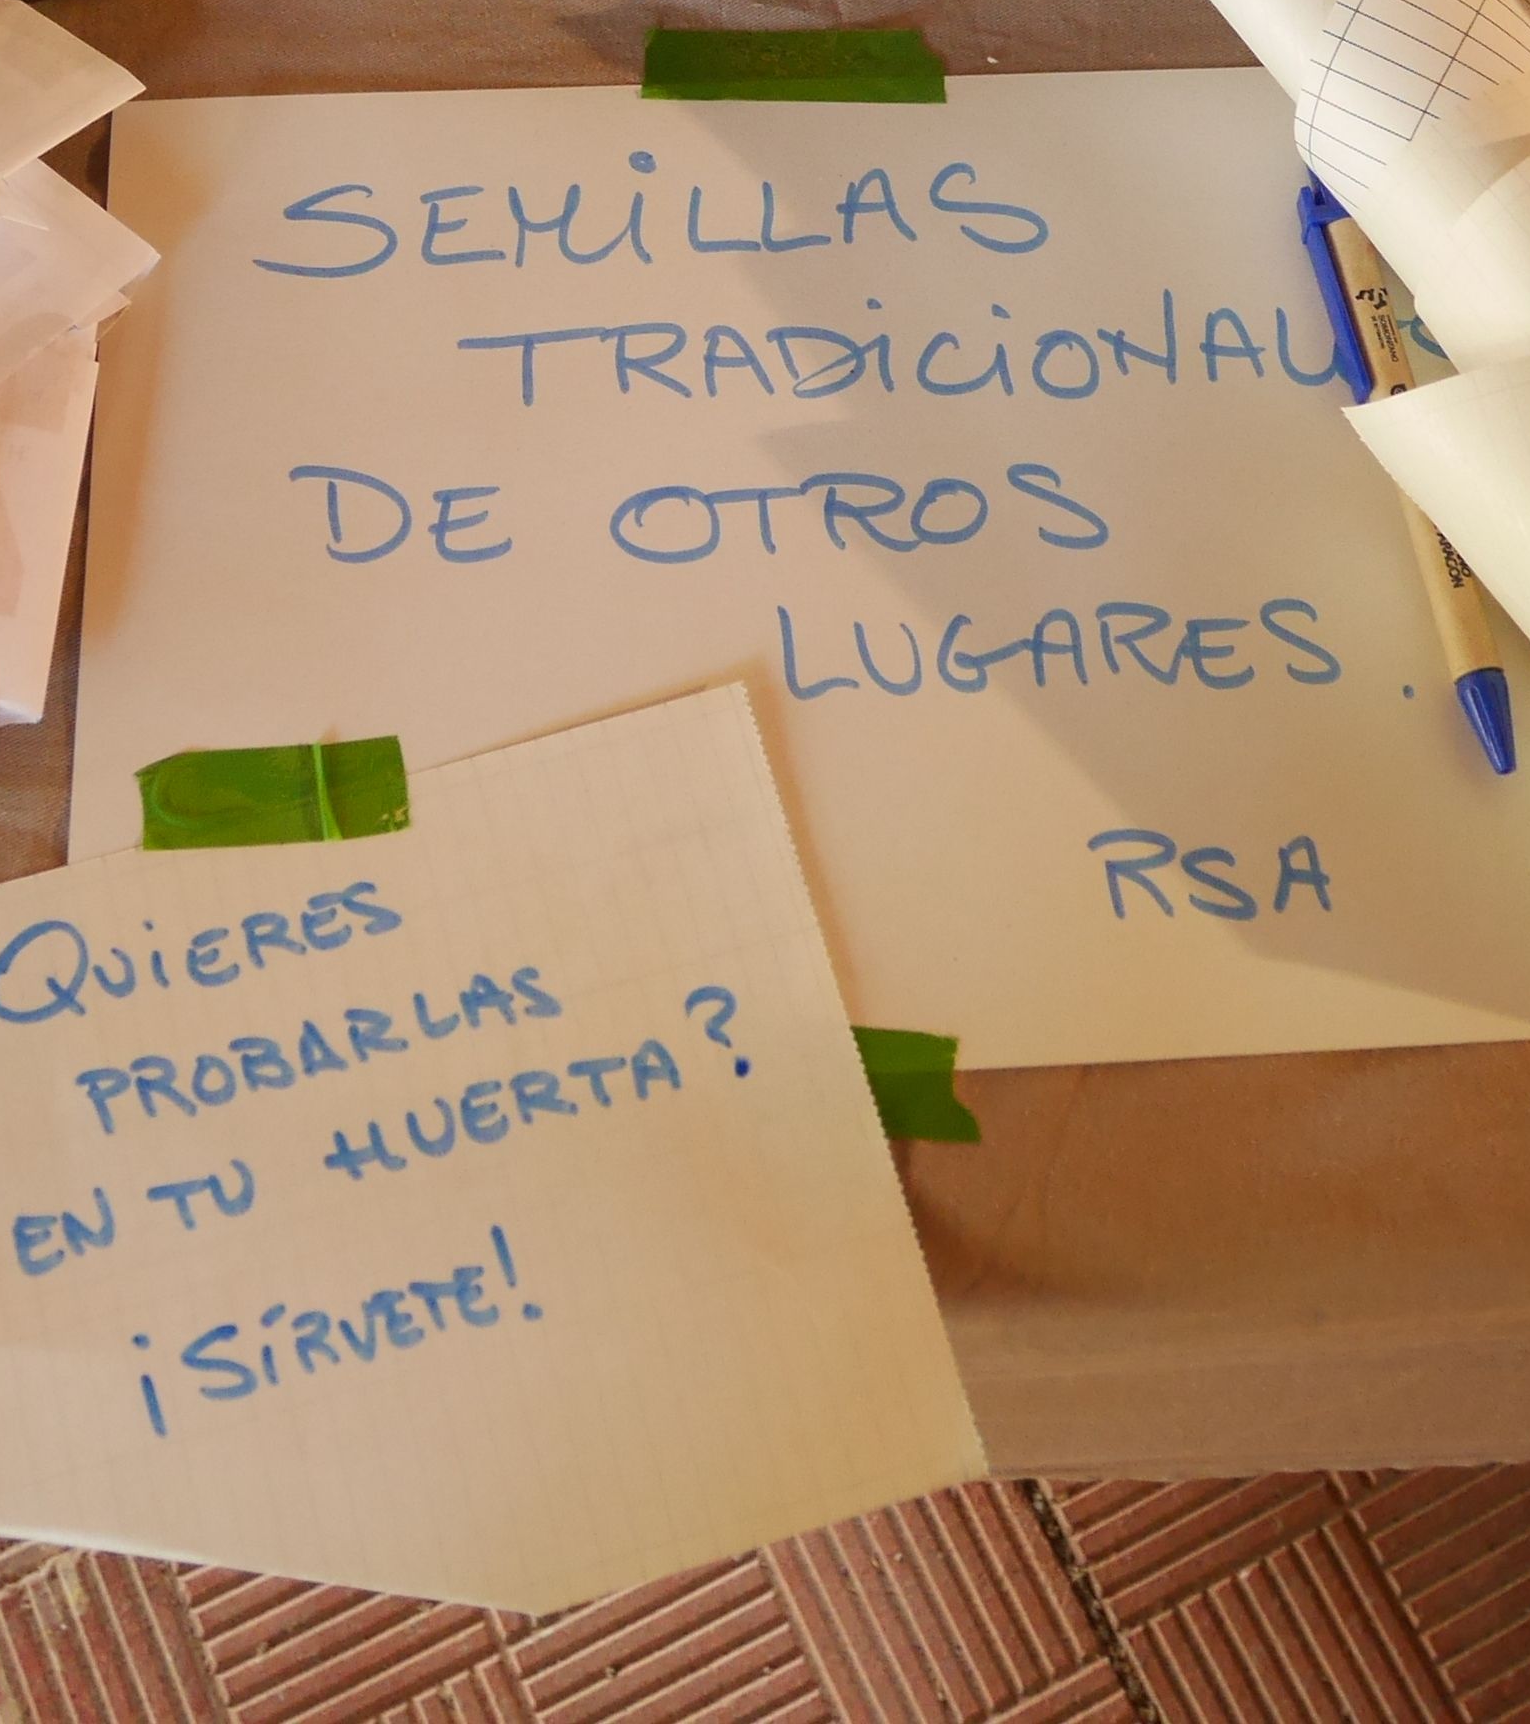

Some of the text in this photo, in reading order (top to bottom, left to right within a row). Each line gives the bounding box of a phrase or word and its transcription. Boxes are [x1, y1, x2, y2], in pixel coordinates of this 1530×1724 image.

[288, 460, 1111, 566] DE OTROS
[1085, 827, 1334, 921] RSA
[76, 967, 562, 1136] PROBARLAS
[12, 1187, 116, 1276] EN
[145, 1159, 254, 1229] TU
